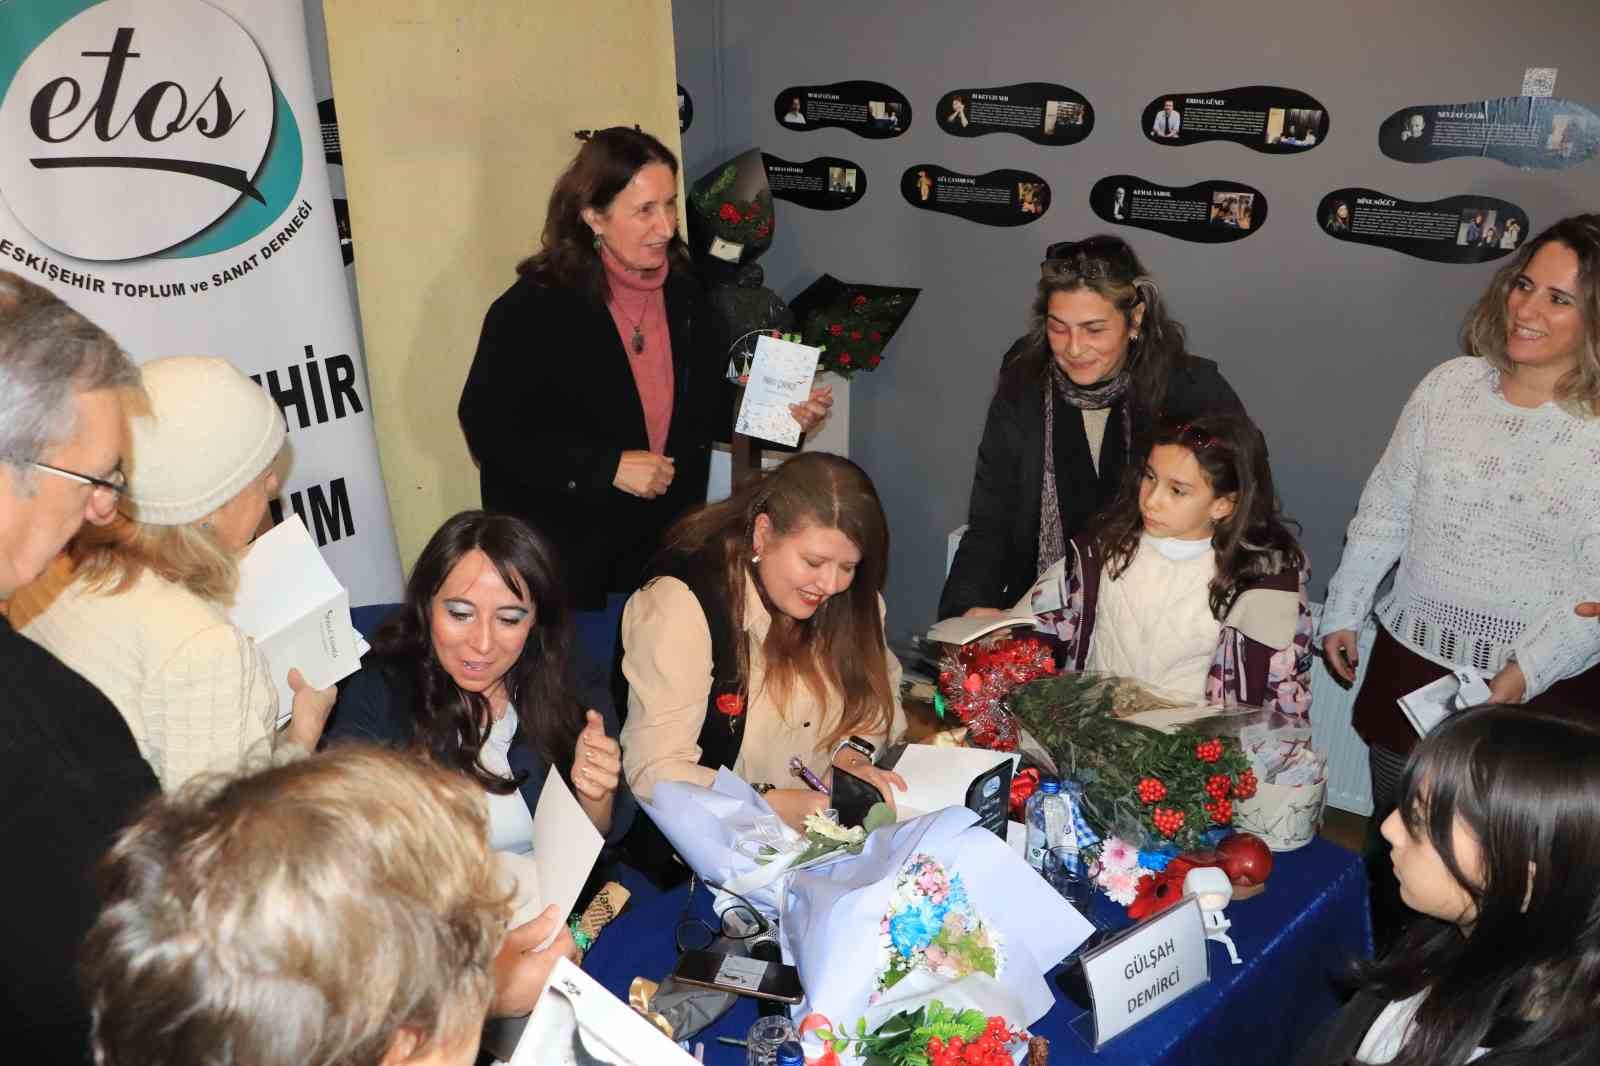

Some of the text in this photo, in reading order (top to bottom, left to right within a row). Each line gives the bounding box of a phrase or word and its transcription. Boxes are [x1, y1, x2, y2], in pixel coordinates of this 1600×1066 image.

[30, 27, 246, 143] etos
[0, 199, 313, 298] ESKİŞEHİR TOPLUM ve SANAT DERNEĞİ
[1124, 937, 1175, 980] GÜLŞAH
[1127, 965, 1180, 1014] DEMİRCİ
